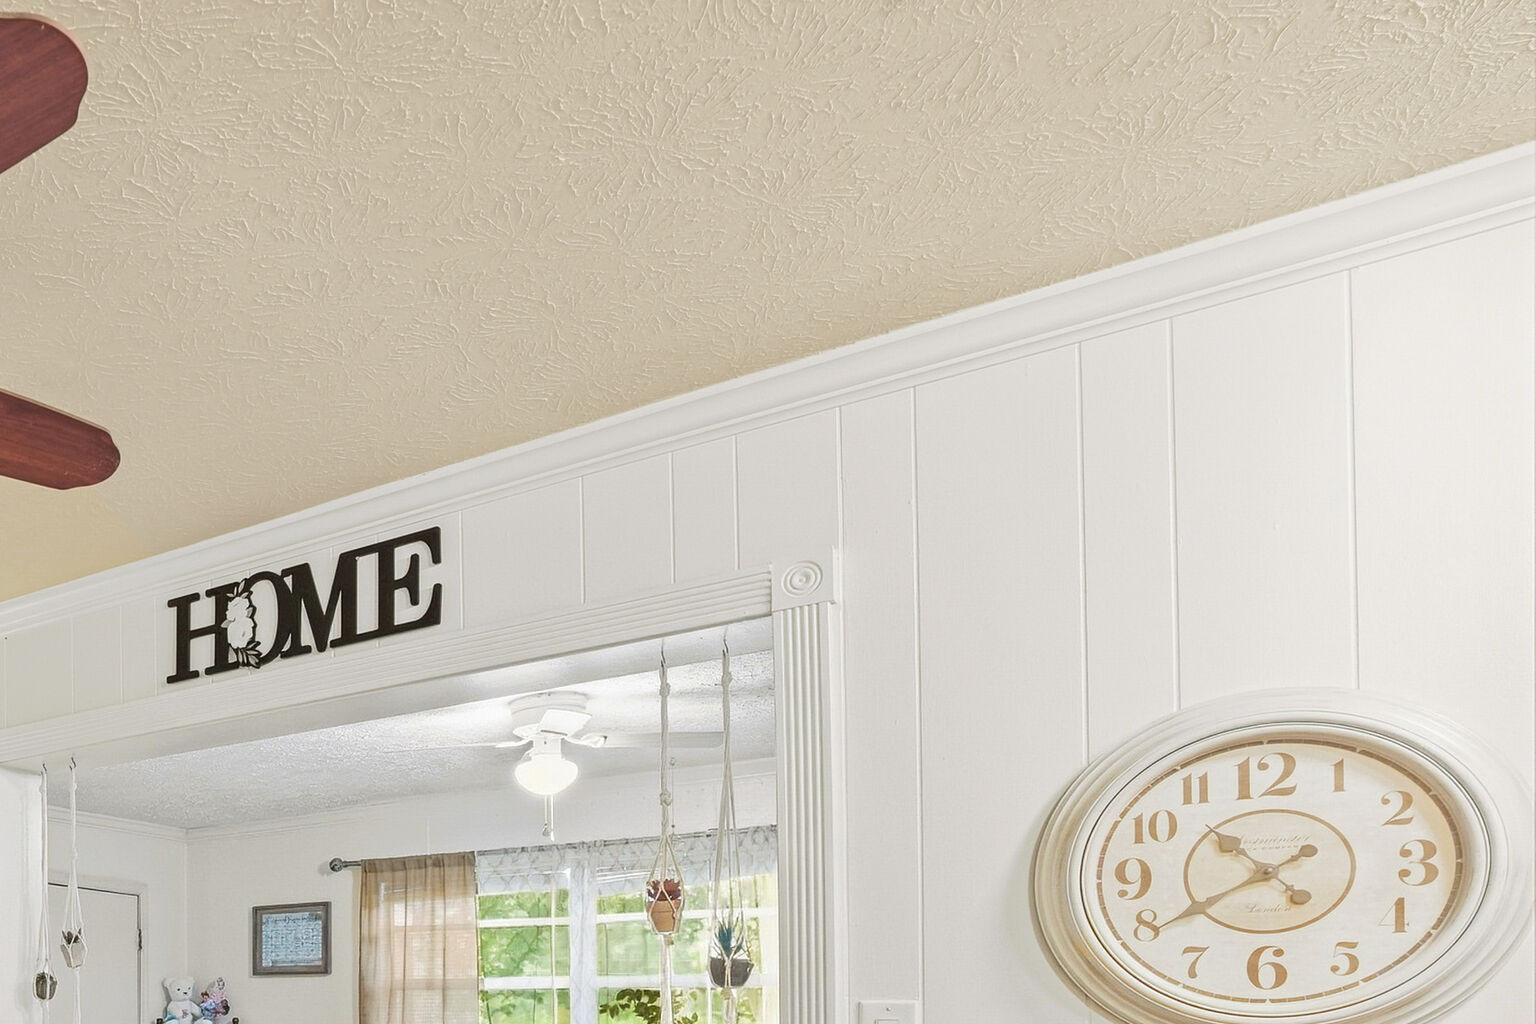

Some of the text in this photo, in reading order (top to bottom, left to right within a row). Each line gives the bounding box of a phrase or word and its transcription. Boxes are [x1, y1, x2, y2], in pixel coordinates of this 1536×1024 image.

[166, 526, 443, 685] HOME
[1180, 771, 1212, 806] 11
[1233, 751, 1298, 801] 12
[1332, 758, 1347, 793] 1
[1131, 809, 1179, 845] 10
[1380, 789, 1415, 827] 2
[1114, 857, 1154, 901] 9
[1397, 839, 1440, 888] 3
[1132, 908, 1161, 942] 8
[1377, 896, 1411, 934] 4
[1180, 945, 1211, 980] 7
[1245, 944, 1289, 991] 6
[1329, 941, 1361, 977] 5
